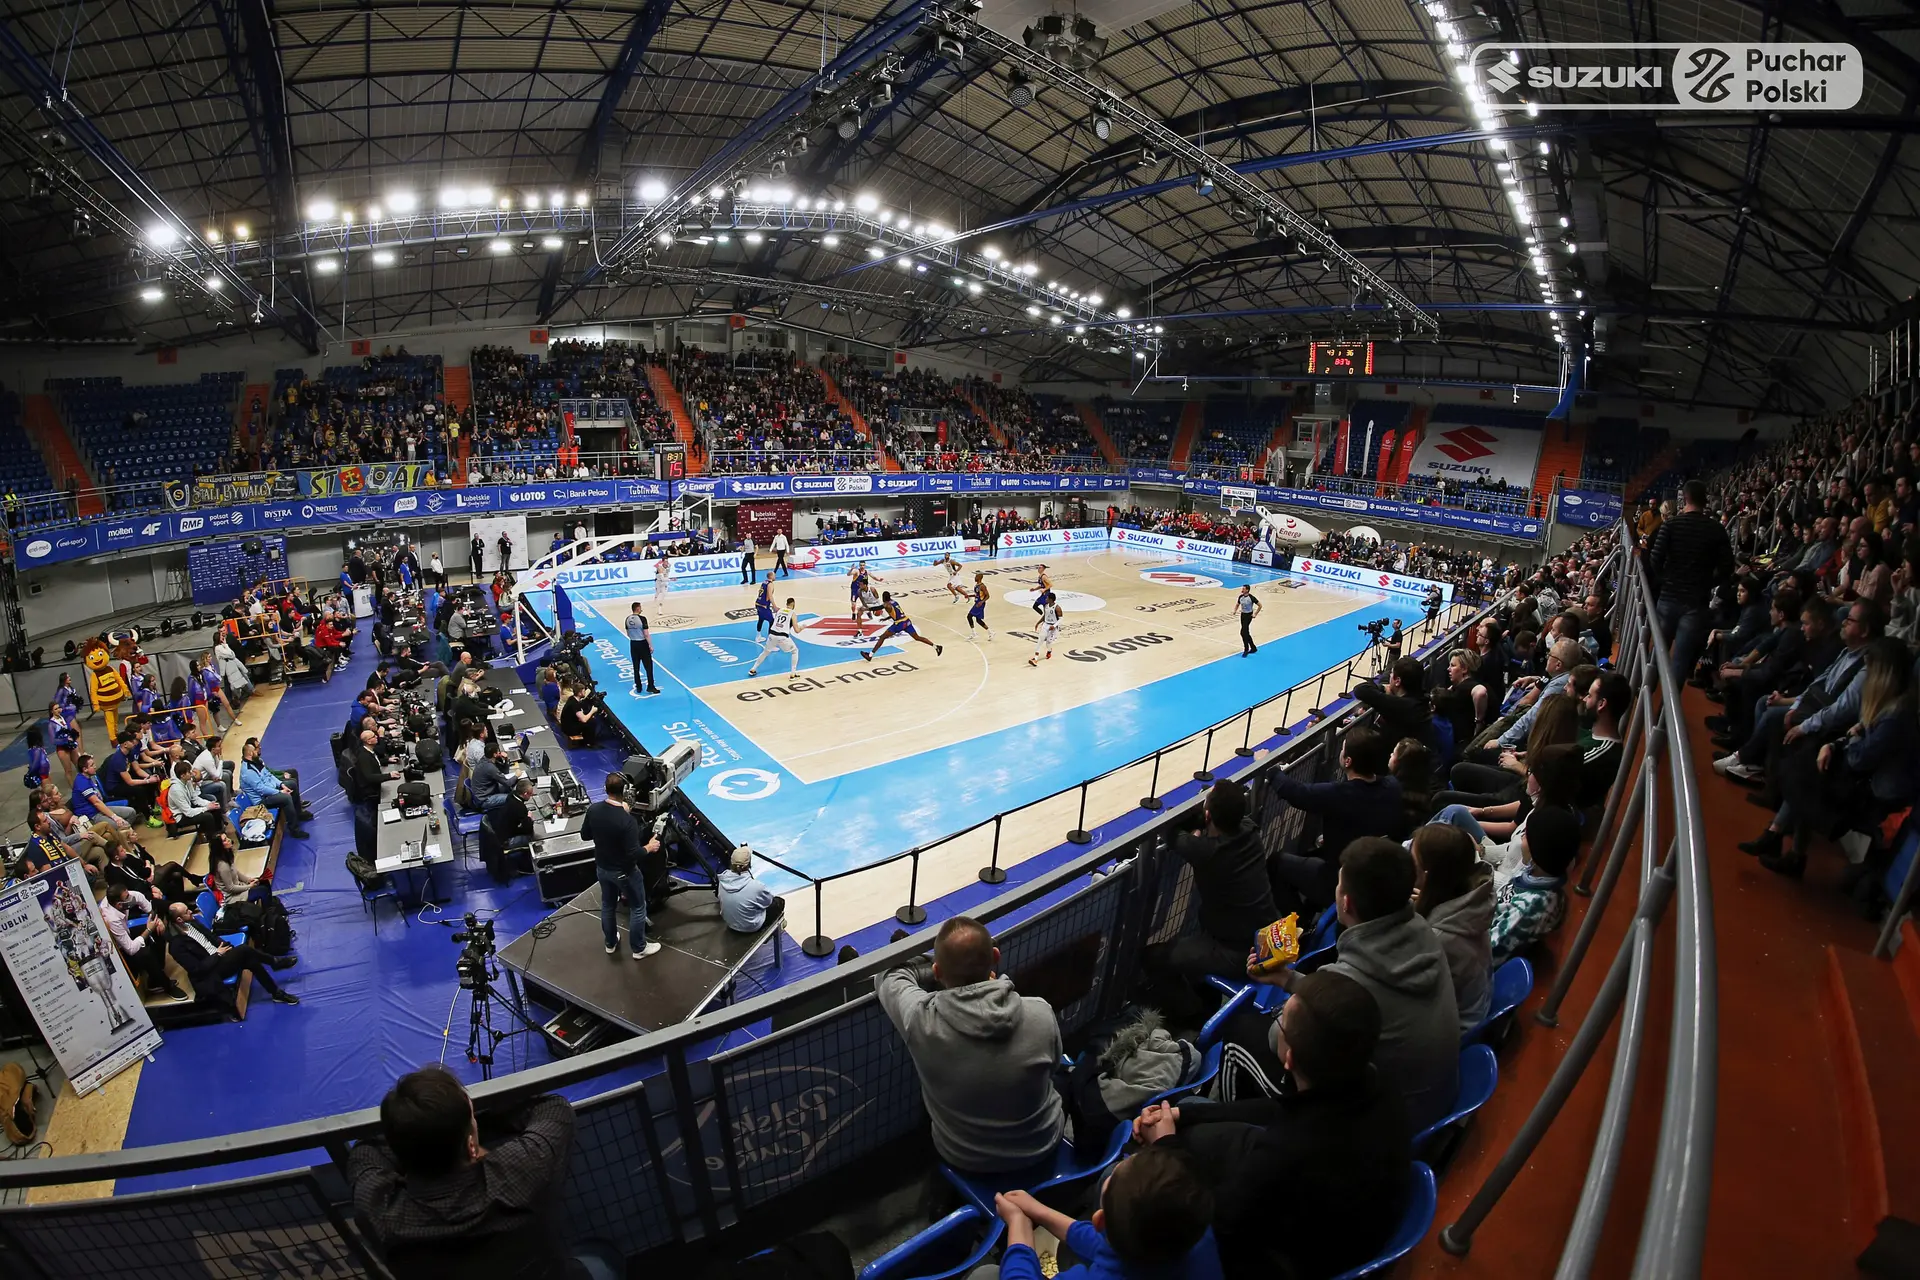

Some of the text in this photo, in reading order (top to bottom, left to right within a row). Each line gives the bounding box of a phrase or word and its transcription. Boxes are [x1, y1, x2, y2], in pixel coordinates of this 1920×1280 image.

[669, 462, 683, 477] 15
[1427, 461, 1491, 475] SUZUKI
[689, 483, 715, 492] Energa
[743, 481, 785, 491] SUZUKI
[887, 479, 918, 487] SUZUKI
[1006, 478, 1020, 486] LOTOS
[520, 491, 546, 501] LOTOS
[569, 488, 609, 498] Bank Pekao
[264, 508, 292, 518] BYSTRA
[1375, 504, 1398, 512] SUZUKI
[209, 513, 229, 522] polsat
[213, 519, 230, 527] sport
[182, 519, 202, 531] RMF
[108, 527, 133, 538] molten
[1072, 530, 1104, 540] SUZUKI
[1279, 528, 1302, 538] Energa
[1015, 533, 1051, 544] SUZUKI
[1127, 533, 1163, 545] SUZUKI
[911, 540, 957, 553] SUZUKI
[1187, 542, 1227, 556] SUZUKI
[824, 546, 879, 560] SUZUKI
[674, 557, 740, 573] SUZUKI
[556, 566, 628, 584] SUZUKI
[1314, 564, 1361, 580] SUZUKI
[1093, 631, 1174, 656] LOTOS
[736, 660, 920, 703] enel-med
[28, 881, 45, 890] Puchar
